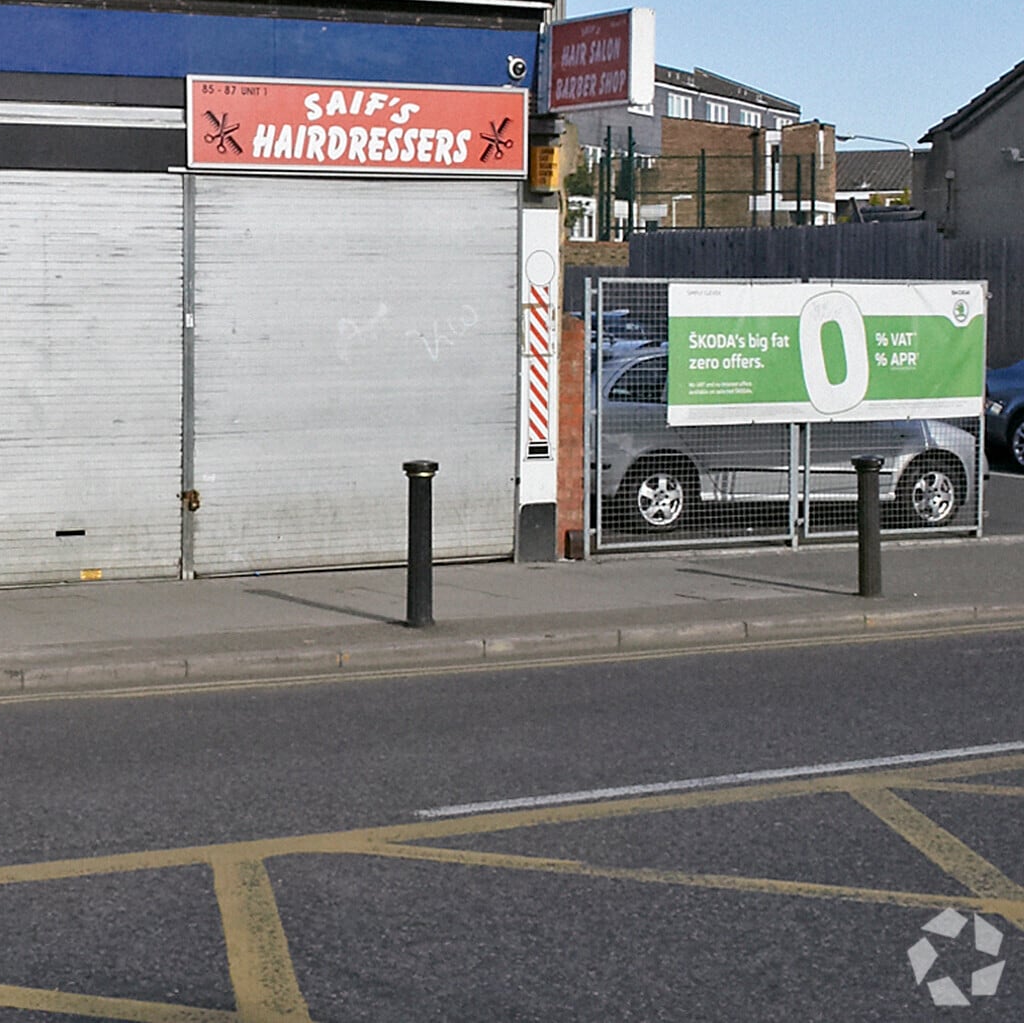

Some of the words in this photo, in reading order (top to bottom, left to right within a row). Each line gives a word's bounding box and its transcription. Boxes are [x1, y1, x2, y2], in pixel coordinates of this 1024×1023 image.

[561, 48, 587, 68] HAIR
[589, 37, 622, 65] SALON
[202, 84, 215, 95] 85
[224, 85, 237, 95] 87
[241, 87, 260, 97] UNIT
[556, 73, 597, 101] BARBER
[599, 68, 627, 96] SHOP
[304, 90, 421, 125] SAIF'S
[252, 124, 471, 165] HAIRDRESSERS
[688, 331, 745, 349] ŠKODA's
[748, 332, 768, 352] big
[771, 332, 790, 348] fat
[875, 333, 889, 347] %
[688, 357, 719, 370] zero
[722, 353, 765, 369] offers.
[874, 352, 888, 367] %
